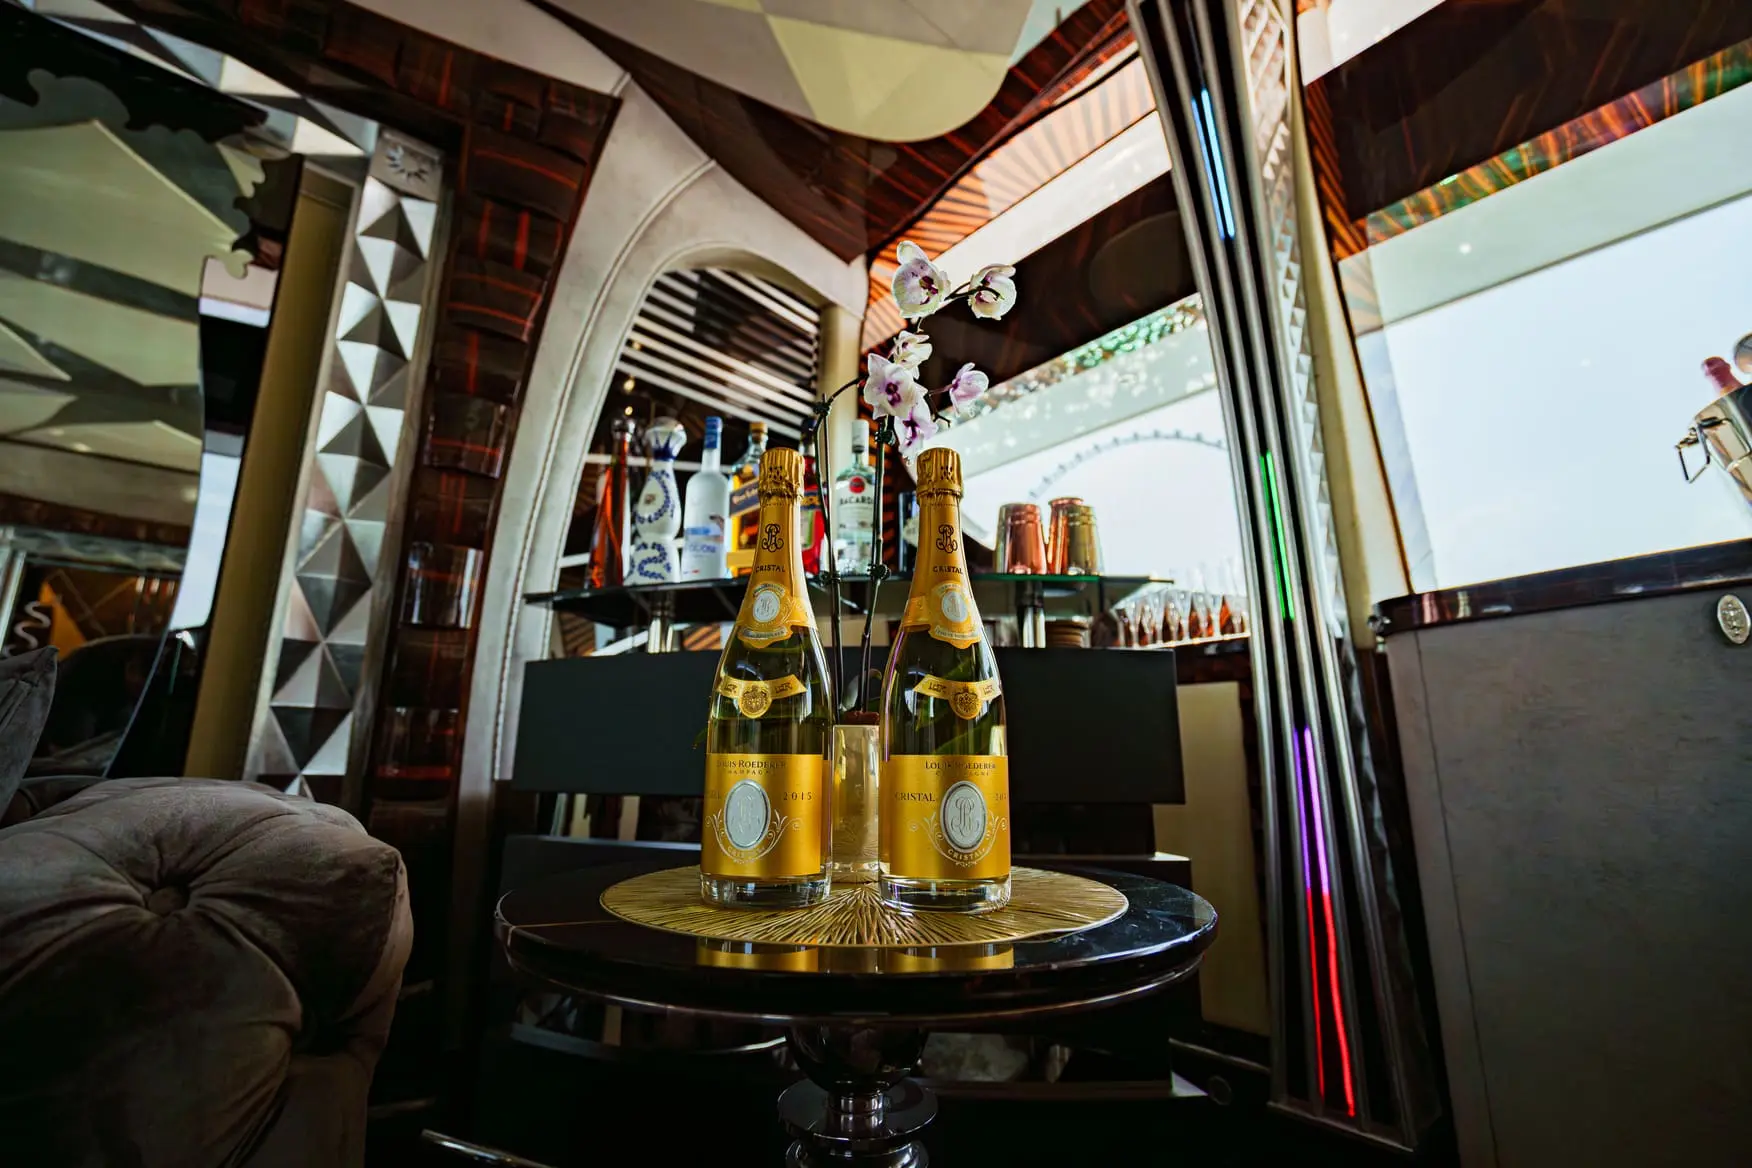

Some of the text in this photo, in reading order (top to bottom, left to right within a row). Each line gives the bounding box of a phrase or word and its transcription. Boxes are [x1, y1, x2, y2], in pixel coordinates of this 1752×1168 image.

[839, 495, 873, 505] BACARD
[755, 564, 786, 573] CRISTAL
[932, 565, 963, 575] CRISTAL
[738, 759, 786, 769] ROEDERER
[783, 791, 813, 801] 2015
[895, 791, 936, 802] CRISTAL
[947, 848, 985, 861] CRISTAL
